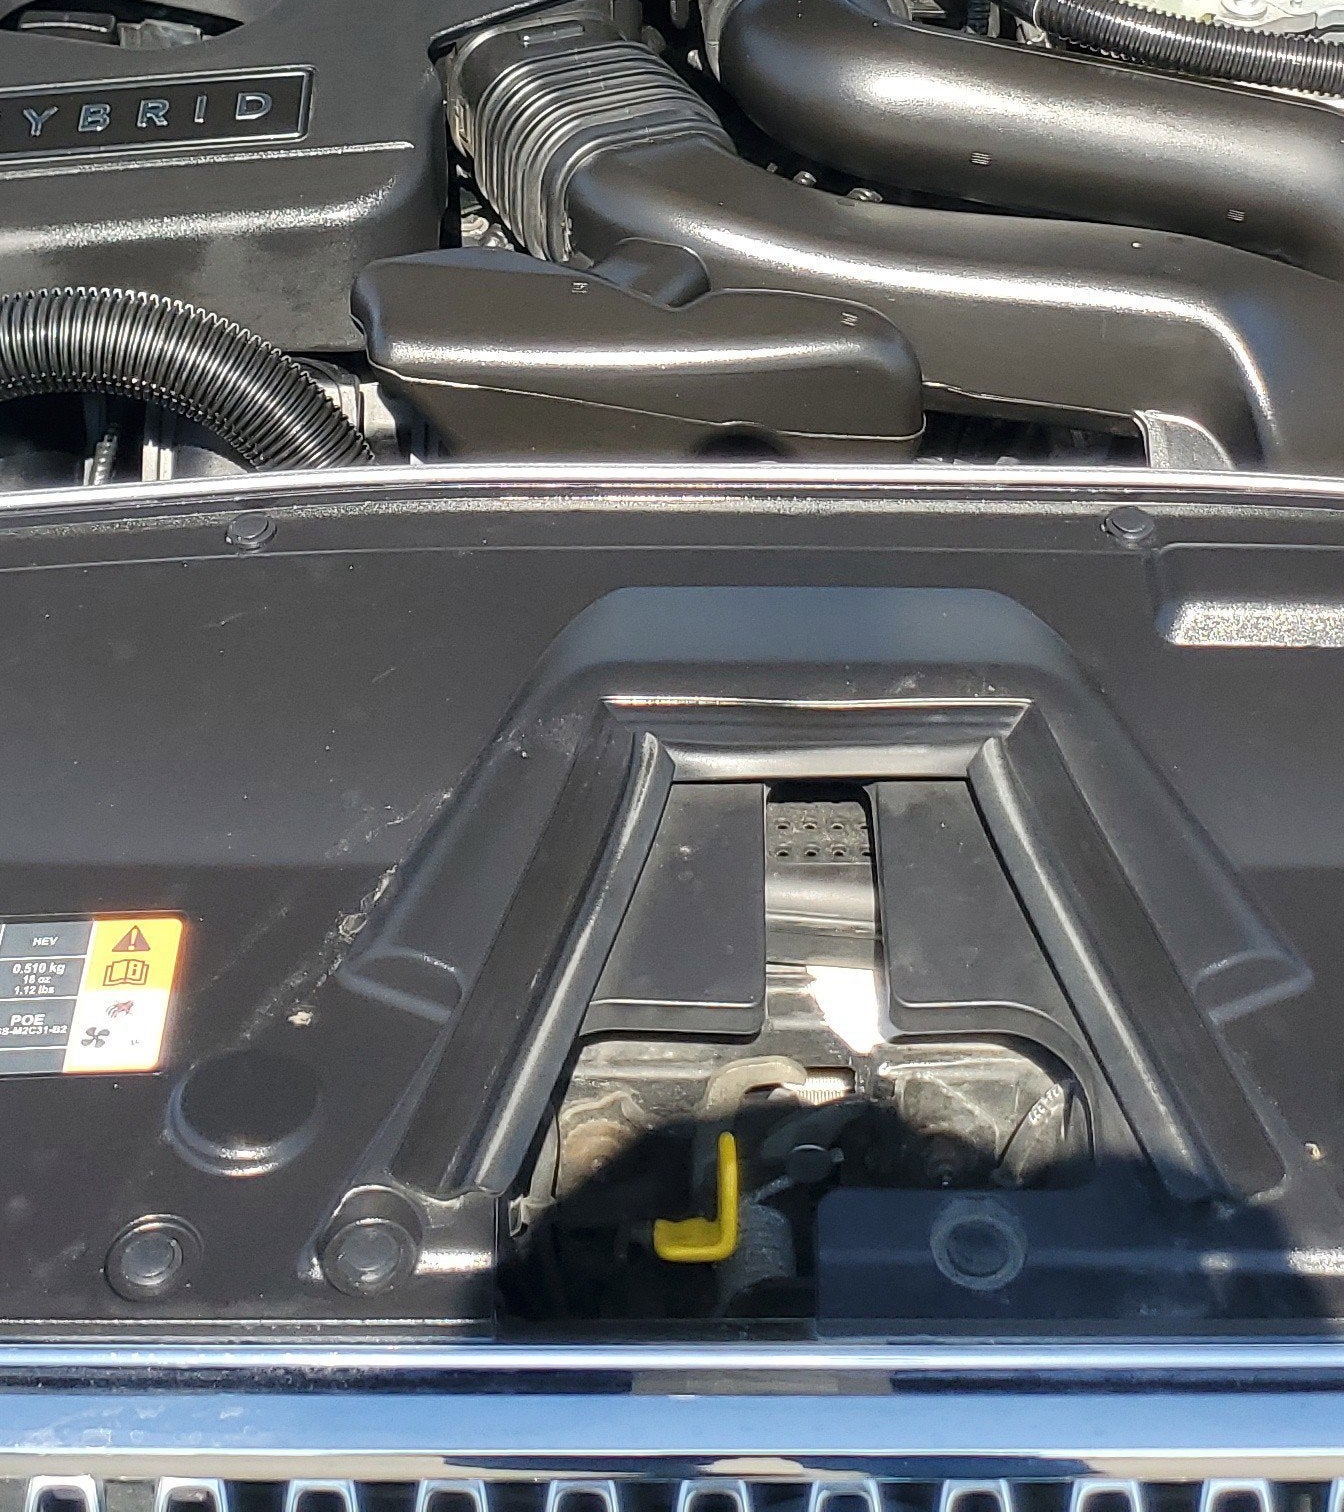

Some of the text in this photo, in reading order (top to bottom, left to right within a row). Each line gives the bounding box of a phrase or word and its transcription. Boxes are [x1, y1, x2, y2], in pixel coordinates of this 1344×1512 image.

[32, 937, 58, 947] HEV
[13, 962, 66, 975] 0.510 kg
[37, 976, 52, 984] oz
[14, 985, 55, 995] 1.12 lbs
[10, 1013, 46, 1026] POE
